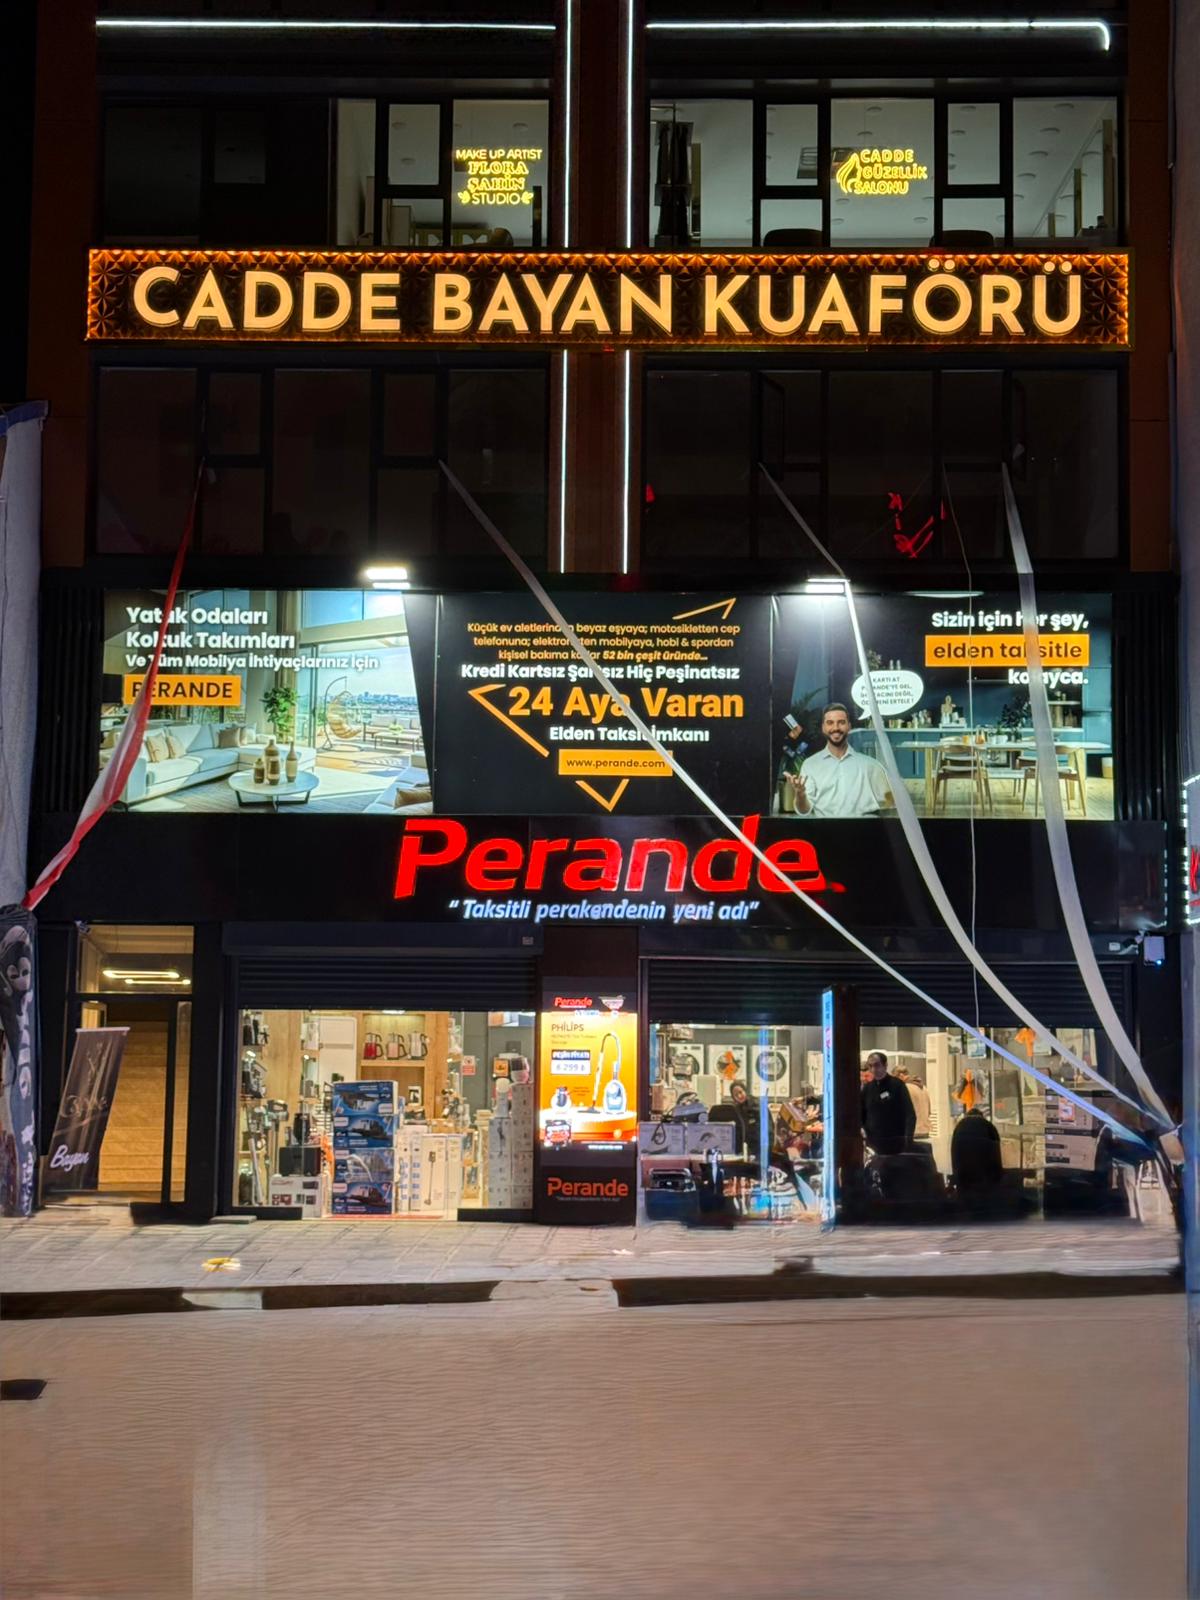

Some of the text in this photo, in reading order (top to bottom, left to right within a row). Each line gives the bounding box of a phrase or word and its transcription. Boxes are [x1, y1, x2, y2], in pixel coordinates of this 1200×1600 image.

[456, 149, 542, 159] MAKE UP ARTIST
[860, 149, 914, 163] CADDE
[468, 161, 529, 174] FLORA
[862, 163, 928, 179] GÜZELLİK
[467, 174, 525, 192] ŞAHİN
[854, 180, 909, 194] SALONU
[472, 192, 520, 204] STUDIO
[133, 258, 1081, 336] CADDE BAYAN KUAFÖRÜ
[191, 608, 268, 624] Odaları
[932, 610, 1089, 631] Sizin için hr şey,
[467, 624, 498, 634] Küçük
[576, 624, 606, 634] beyaz
[608, 625, 648, 635] eşyaya;
[650, 624, 718, 633] motosikletten
[720, 626, 740, 635] cep
[196, 632, 295, 649] Takımları
[473, 637, 531, 647] telefonuna;
[599, 638, 655, 649] mobilyaya,
[656, 638, 680, 647] hobi
[681, 638, 689, 647] &
[691, 638, 733, 649] spordan
[498, 650, 529, 661] kişisel
[530, 650, 569, 659] bakıma
[602, 651, 616, 659] 52
[617, 651, 634, 660] bin
[635, 651, 661, 663] çeşit
[933, 642, 994, 659] elden
[126, 655, 146, 667] Ve
[185, 654, 246, 671] Mobilya
[249, 653, 348, 671] İhtiyaçlarınız
[351, 656, 379, 671] İçin
[461, 663, 740, 682] Kredi Kartsız Şarsız Hiç Peşinatsız
[1008, 669, 1089, 688] koyca.
[508, 686, 744, 724] 24 Aya Varan
[550, 728, 595, 741] Elden
[651, 725, 710, 742] İmkanı
[566, 758, 666, 769] www.perande.com
[394, 814, 823, 898] Perande
[534, 899, 666, 923] perakendenin
[673, 901, 715, 924] yeni
[554, 997, 593, 1007] Perande
[50, 1144, 90, 1172] Bayan
[547, 1177, 628, 1196] Perande
